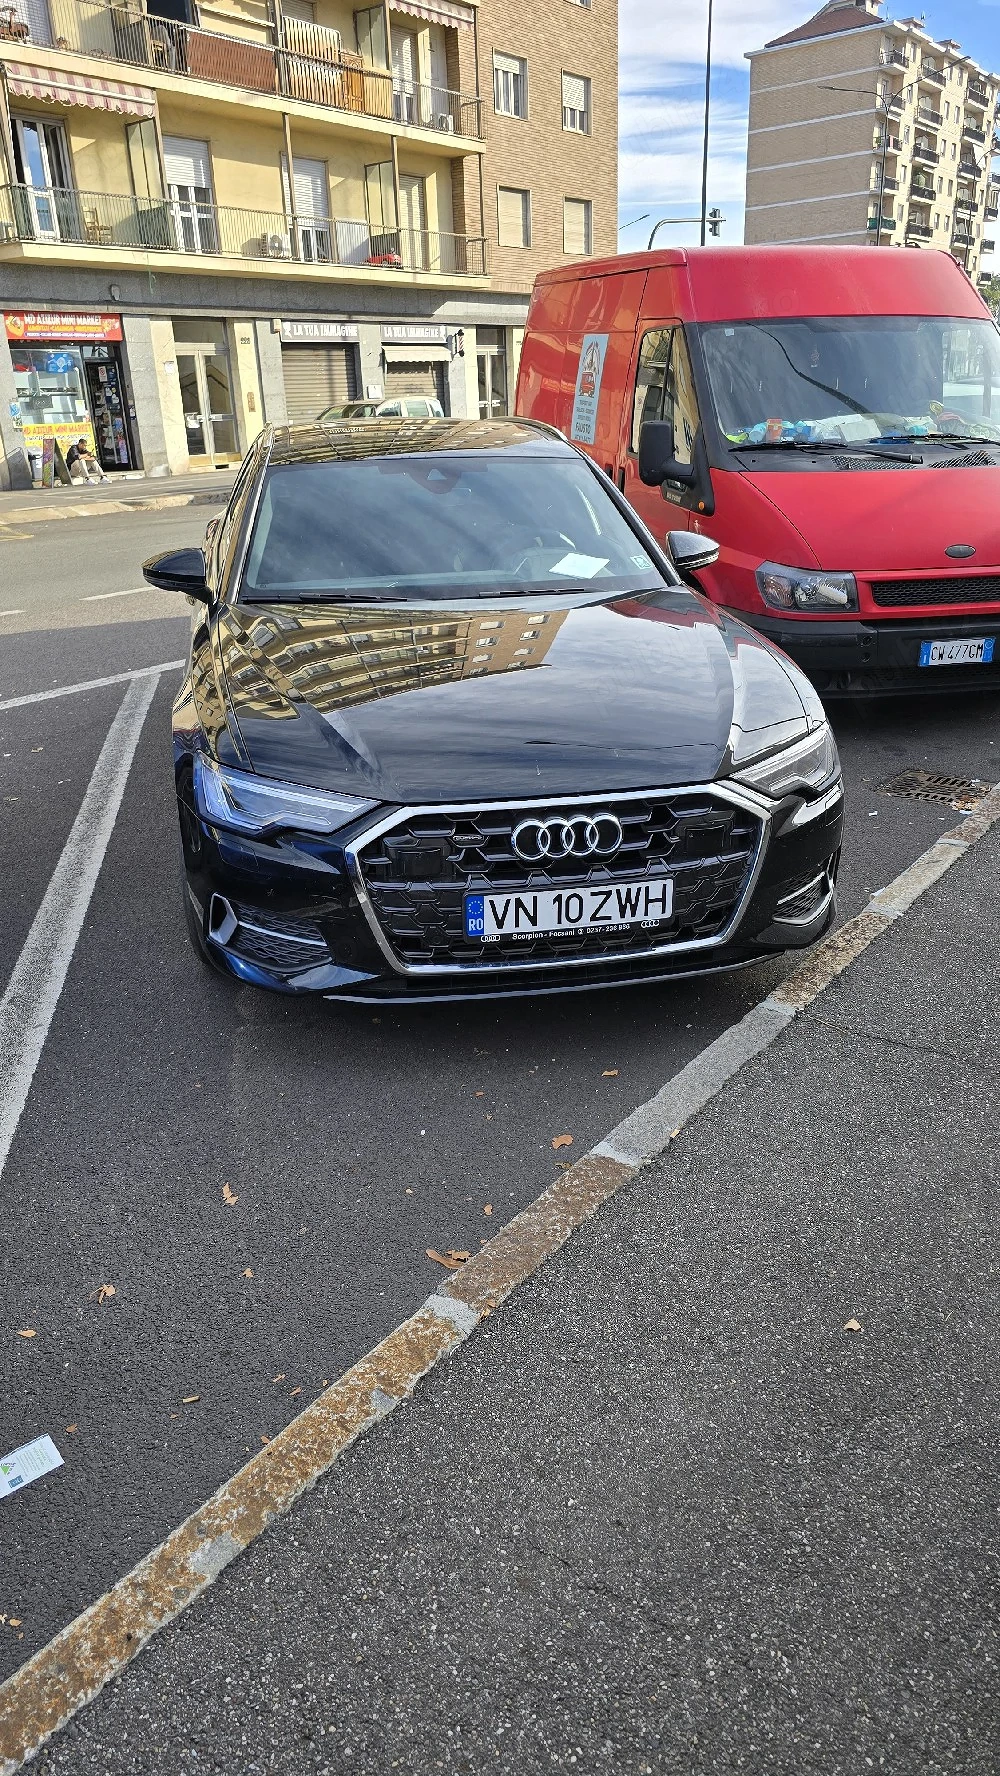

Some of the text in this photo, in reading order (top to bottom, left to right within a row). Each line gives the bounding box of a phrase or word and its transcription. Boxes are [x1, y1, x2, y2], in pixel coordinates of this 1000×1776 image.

[77, 315, 101, 325] MARKET
[293, 324, 358, 337] LA TUA IMMAGINE
[384, 326, 439, 338] LA TUA IMMAGINE
[576, 422, 592, 434] FAUSTO
[489, 896, 538, 929] VN
[468, 918, 483, 931] RO
[512, 932, 543, 940] Scorpion
